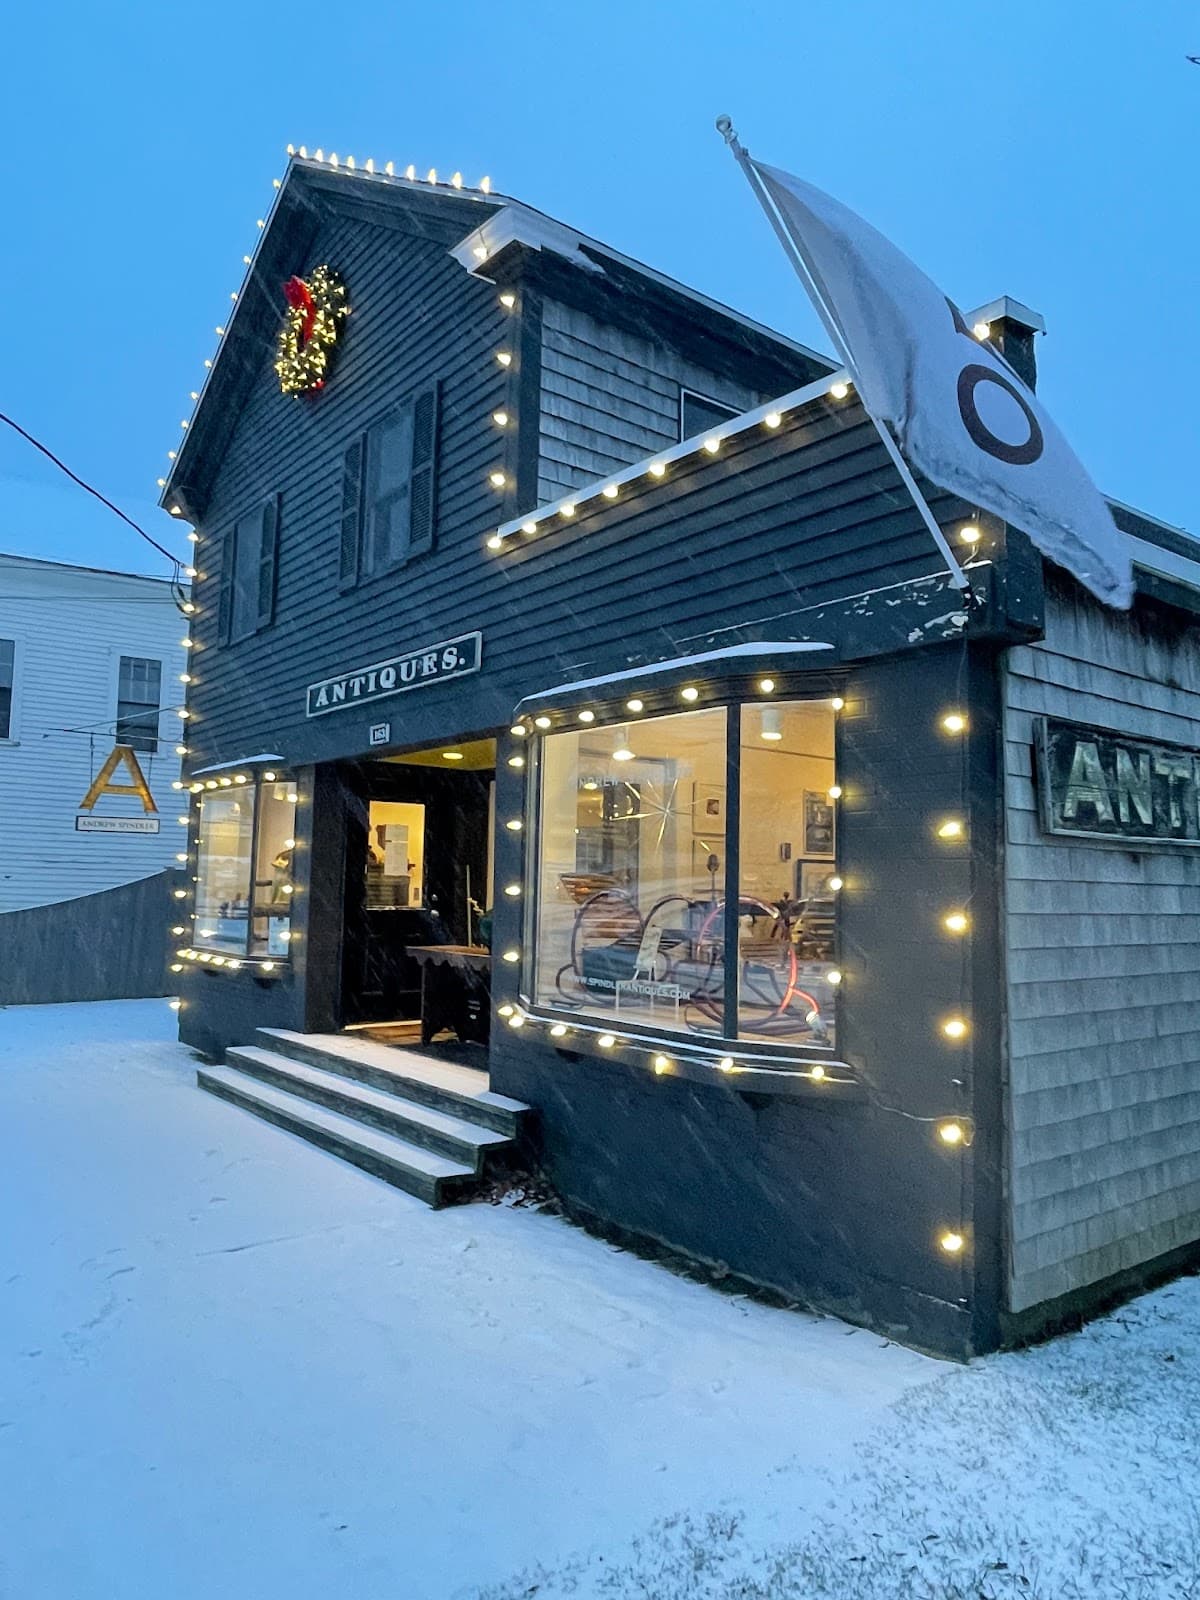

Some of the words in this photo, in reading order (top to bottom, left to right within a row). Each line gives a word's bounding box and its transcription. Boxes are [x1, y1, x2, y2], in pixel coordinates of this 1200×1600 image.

[316, 647, 466, 707] ANTIQUES.
[79, 744, 159, 813] A
[82, 819, 116, 828] ANDREW
